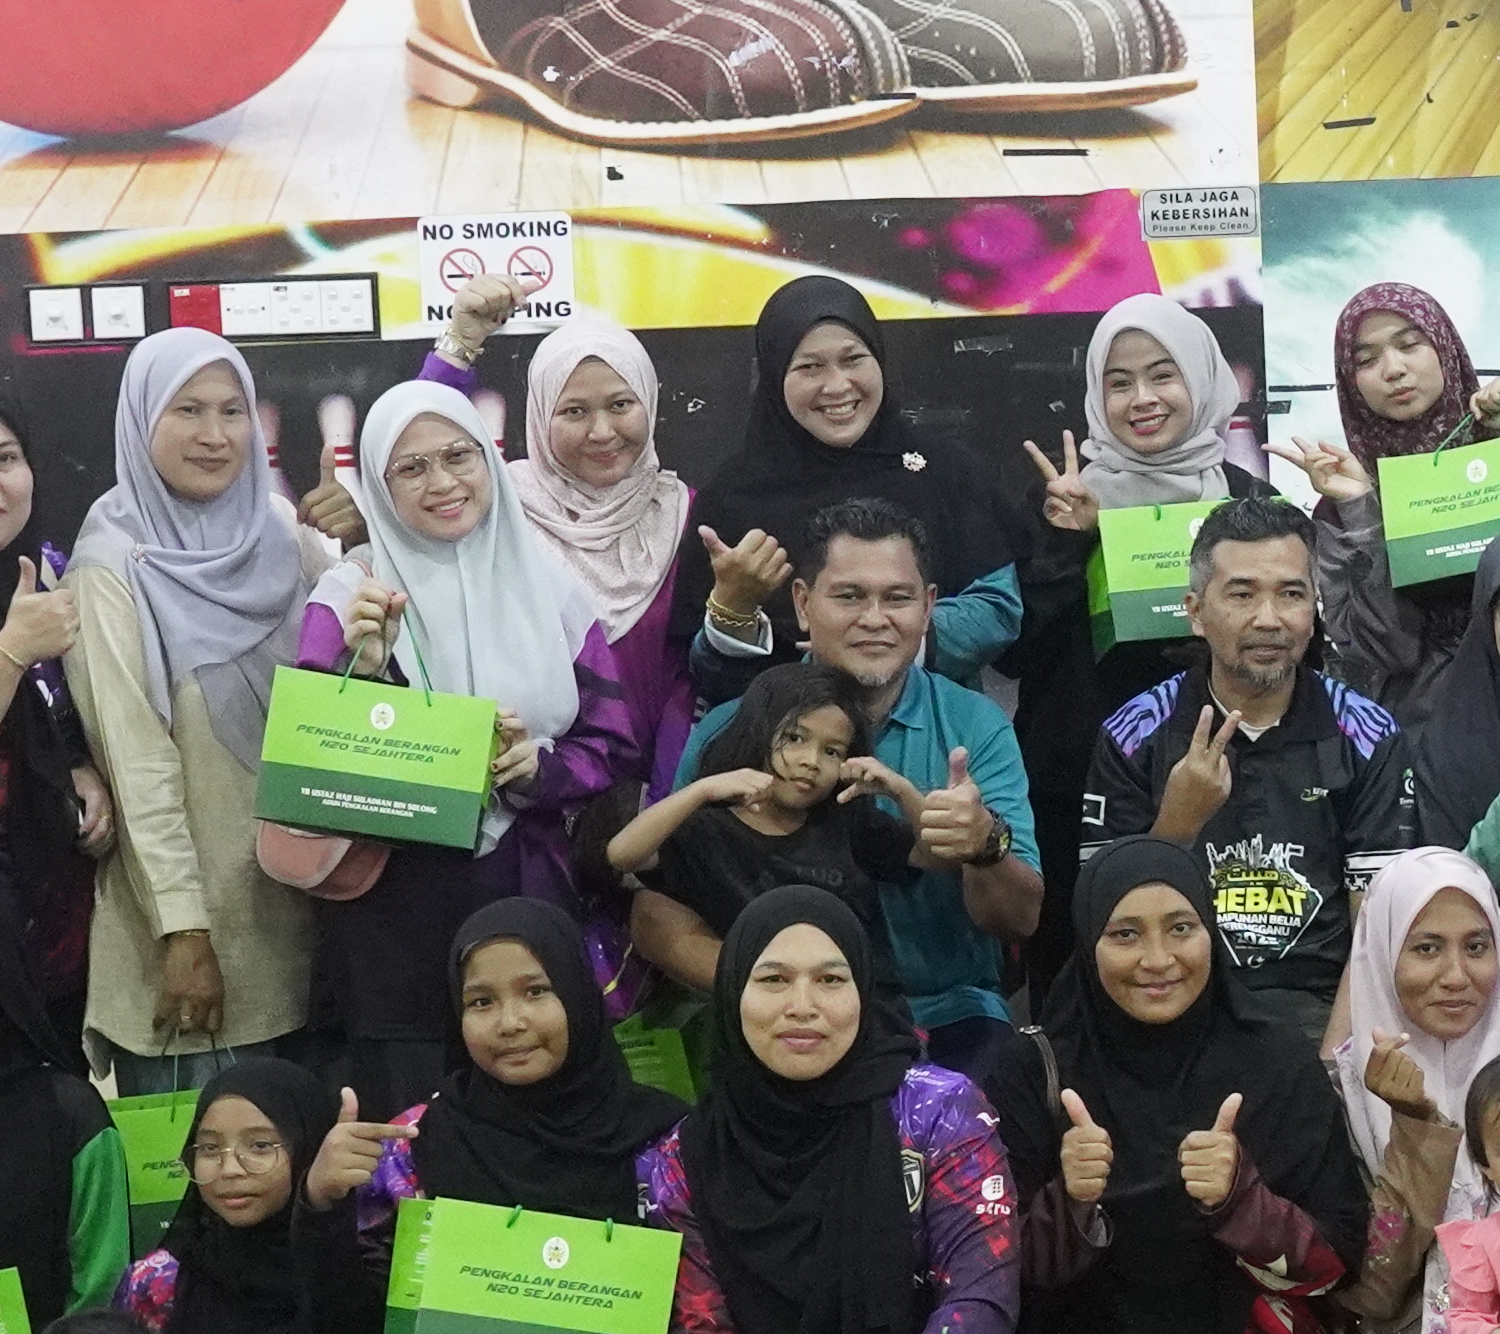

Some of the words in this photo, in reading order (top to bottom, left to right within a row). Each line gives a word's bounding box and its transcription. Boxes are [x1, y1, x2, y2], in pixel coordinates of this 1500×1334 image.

[1160, 192, 1193, 204] SILA
[1200, 191, 1239, 202] JAGA
[1151, 207, 1249, 221] KEBERSIHAN
[423, 225, 453, 240] NO
[463, 221, 568, 239] SMOKING
[1220, 222, 1248, 230] Clean
[1269, 914, 1301, 927] BELIA
[458, 1265, 555, 1287] PENGKALAN
[556, 1279, 643, 1300] BERANGAN
[522, 1287, 613, 1309] SEJAHTERA
